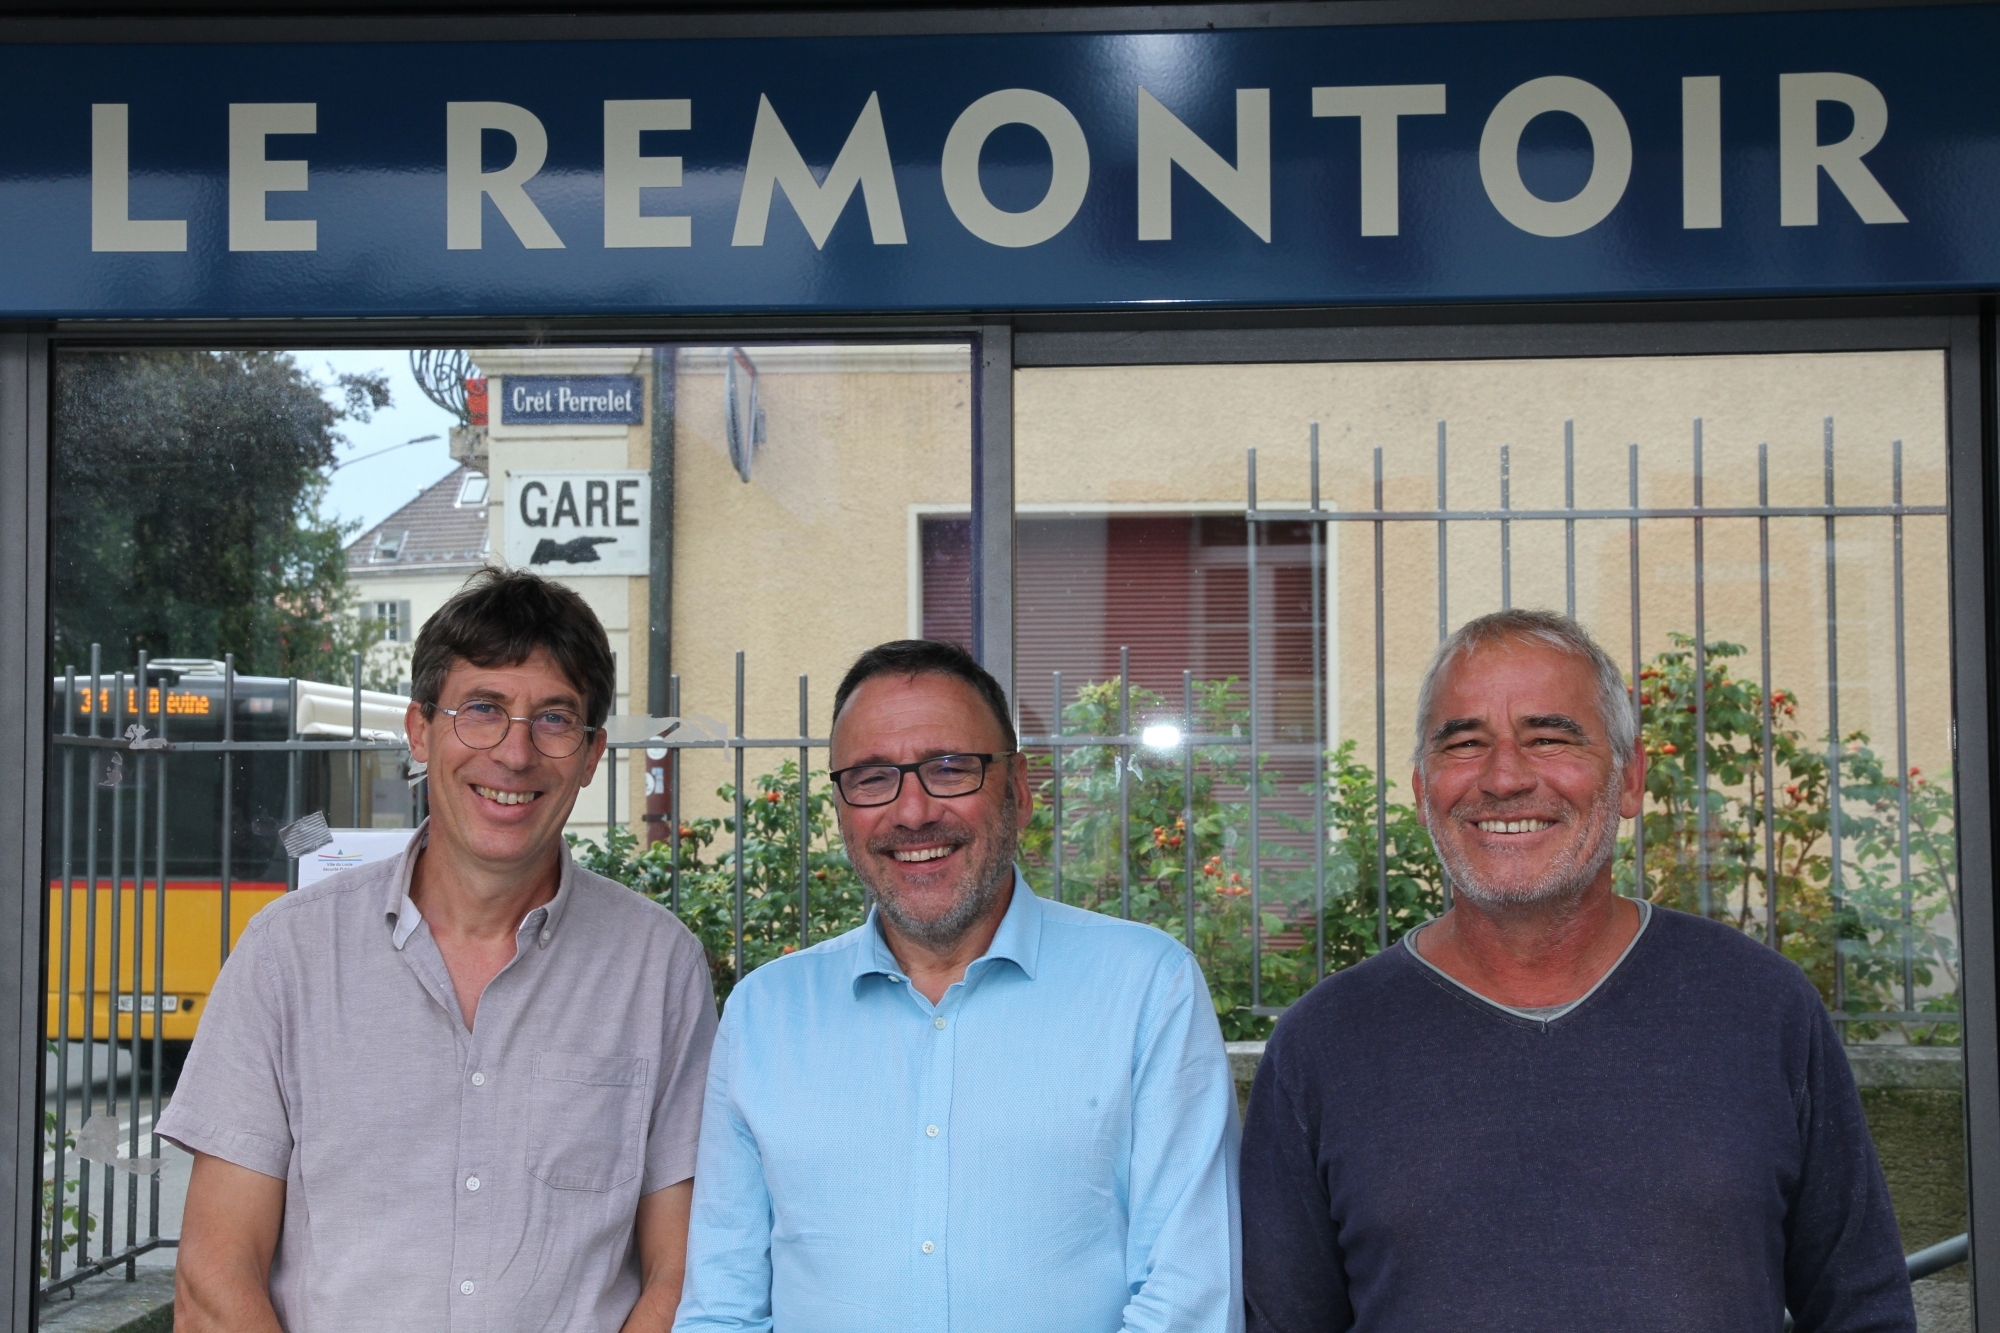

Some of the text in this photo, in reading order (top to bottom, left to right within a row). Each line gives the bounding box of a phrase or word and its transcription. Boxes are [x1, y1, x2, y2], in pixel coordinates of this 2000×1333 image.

[91, 72, 1910, 252] LE REMONTOIR
[558, 386, 633, 413] Perrelet
[519, 479, 640, 528] GARE
[80, 687, 110, 713] 31
[148, 687, 210, 714] Bévine
